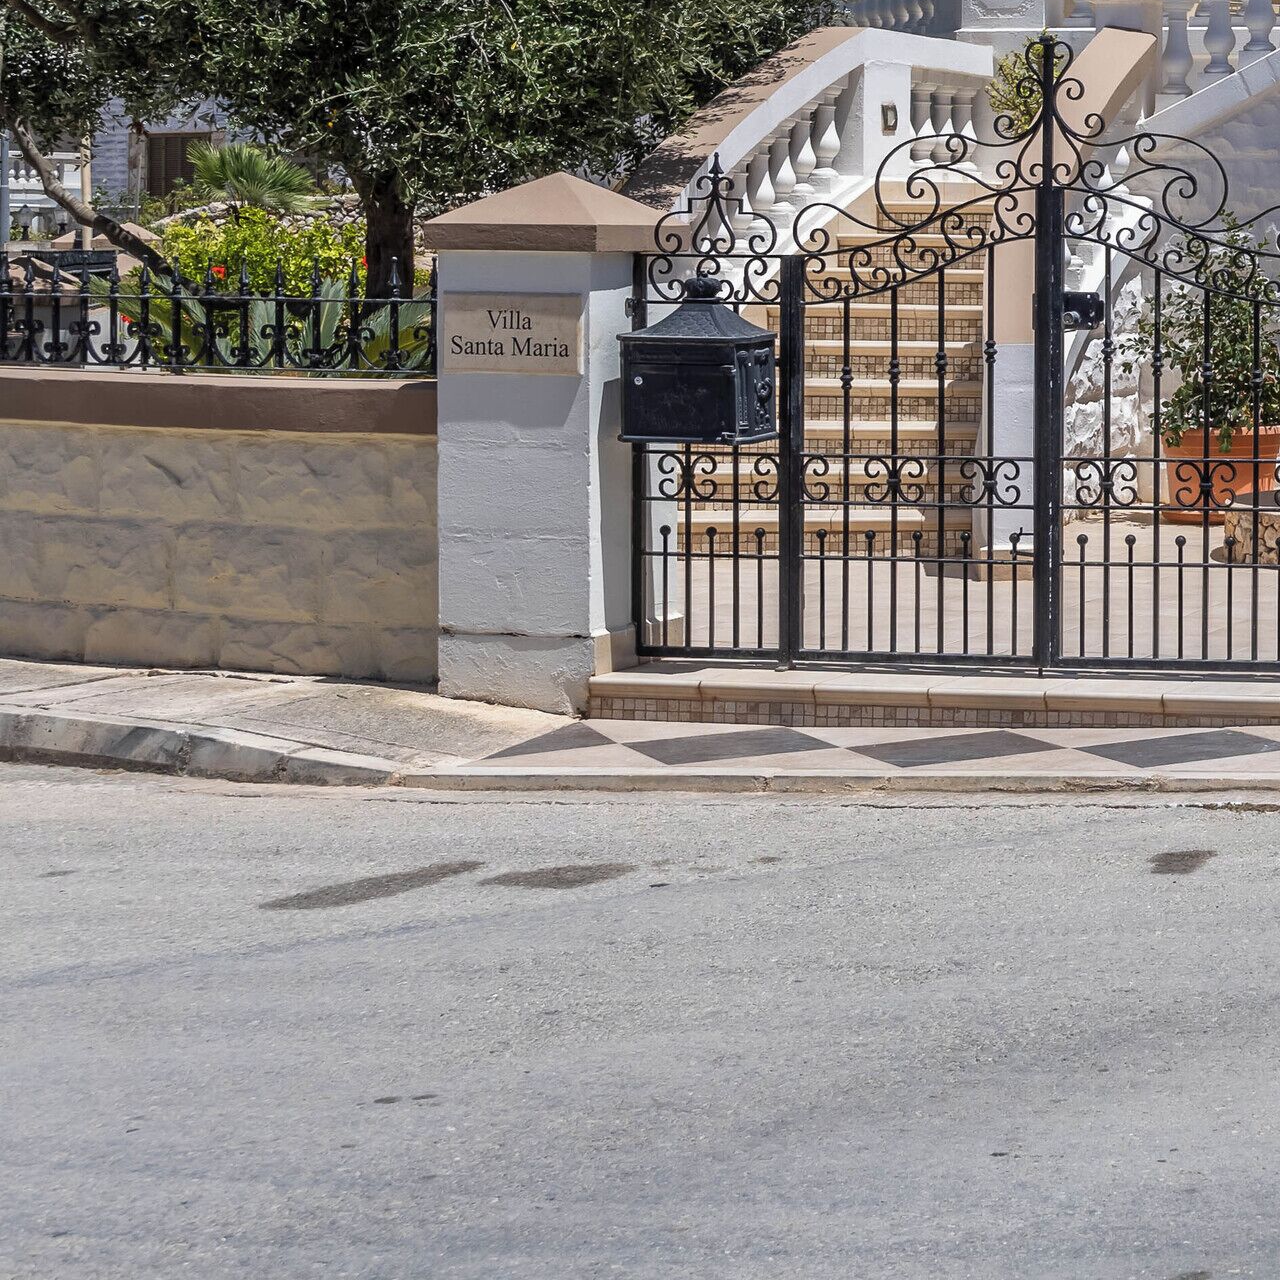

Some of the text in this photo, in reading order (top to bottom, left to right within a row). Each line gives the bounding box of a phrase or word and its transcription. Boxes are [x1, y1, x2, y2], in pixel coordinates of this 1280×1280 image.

[486, 309, 532, 330] Villa
[451, 335, 570, 358] Santa Maria
